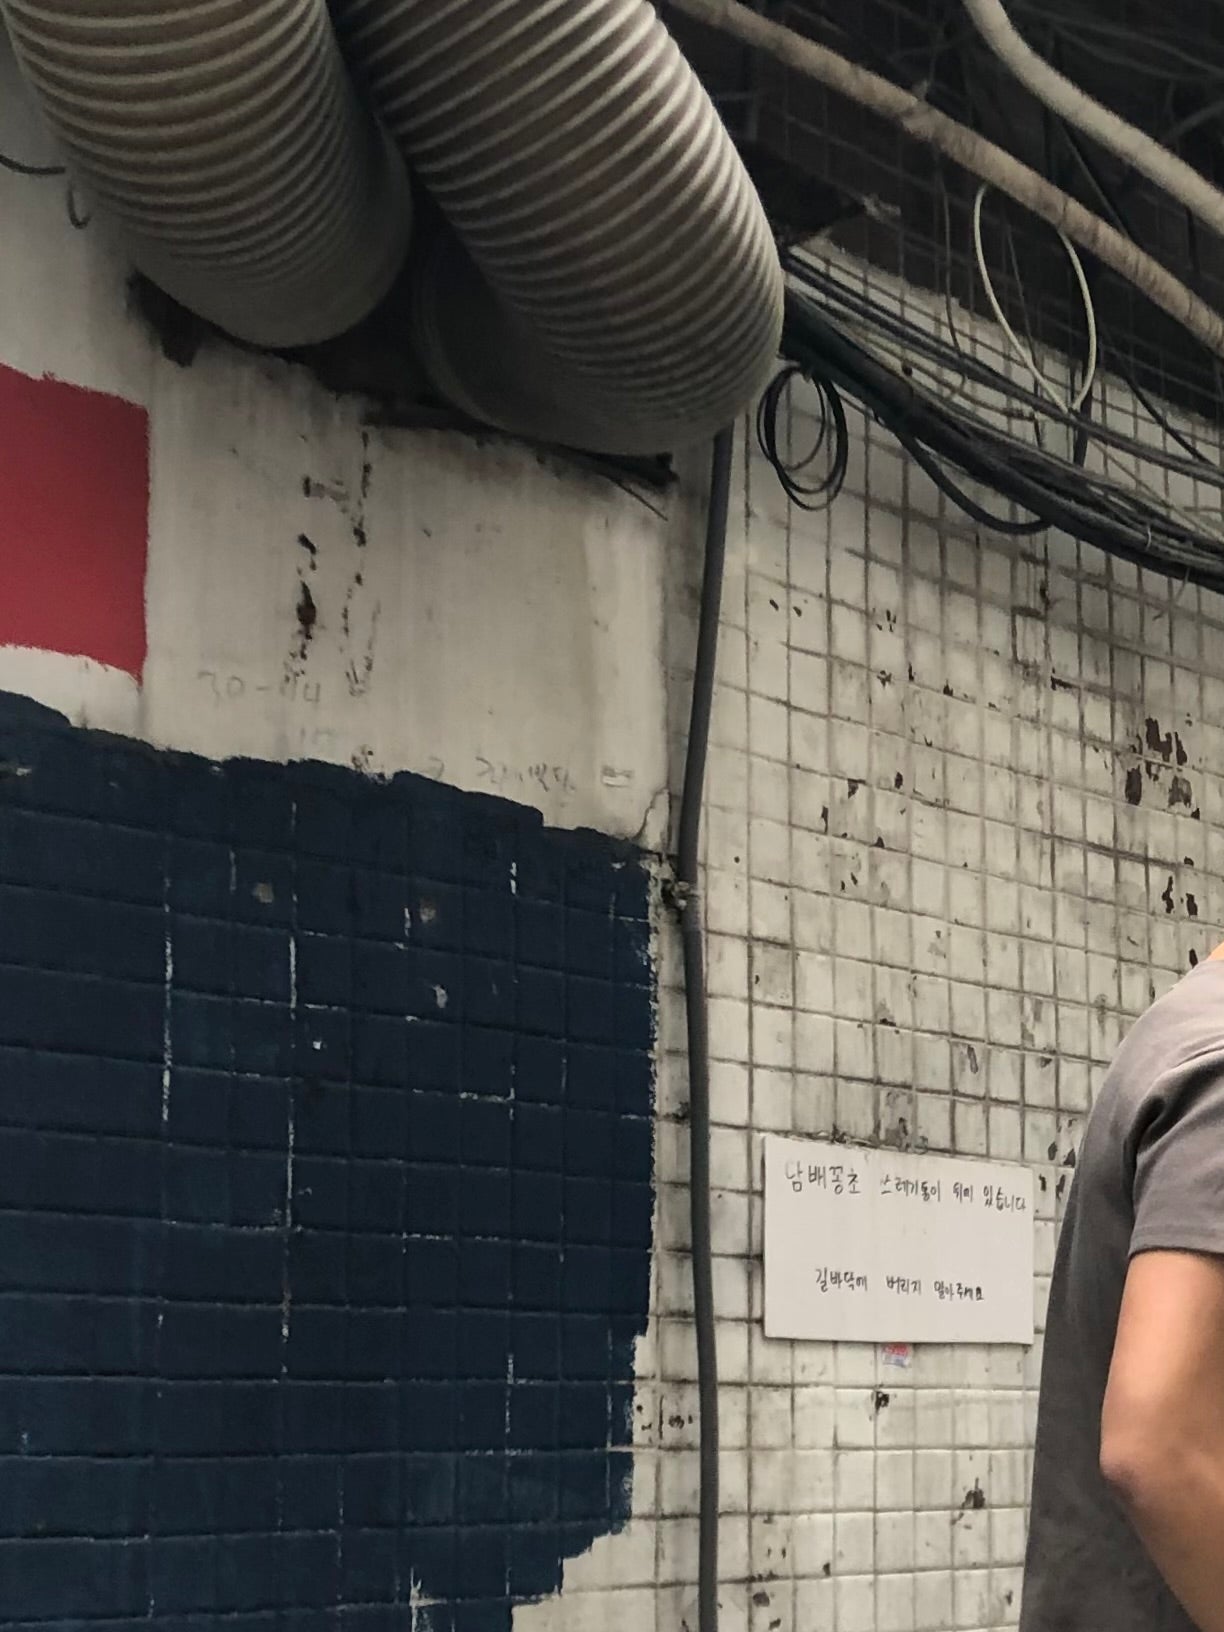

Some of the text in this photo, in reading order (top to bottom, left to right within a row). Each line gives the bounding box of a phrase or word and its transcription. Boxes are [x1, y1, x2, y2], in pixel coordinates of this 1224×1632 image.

[982, 1184, 1027, 1212] 있습니다
[815, 1266, 868, 1293] 길바닥에
[885, 1274, 922, 1296] 버리지
